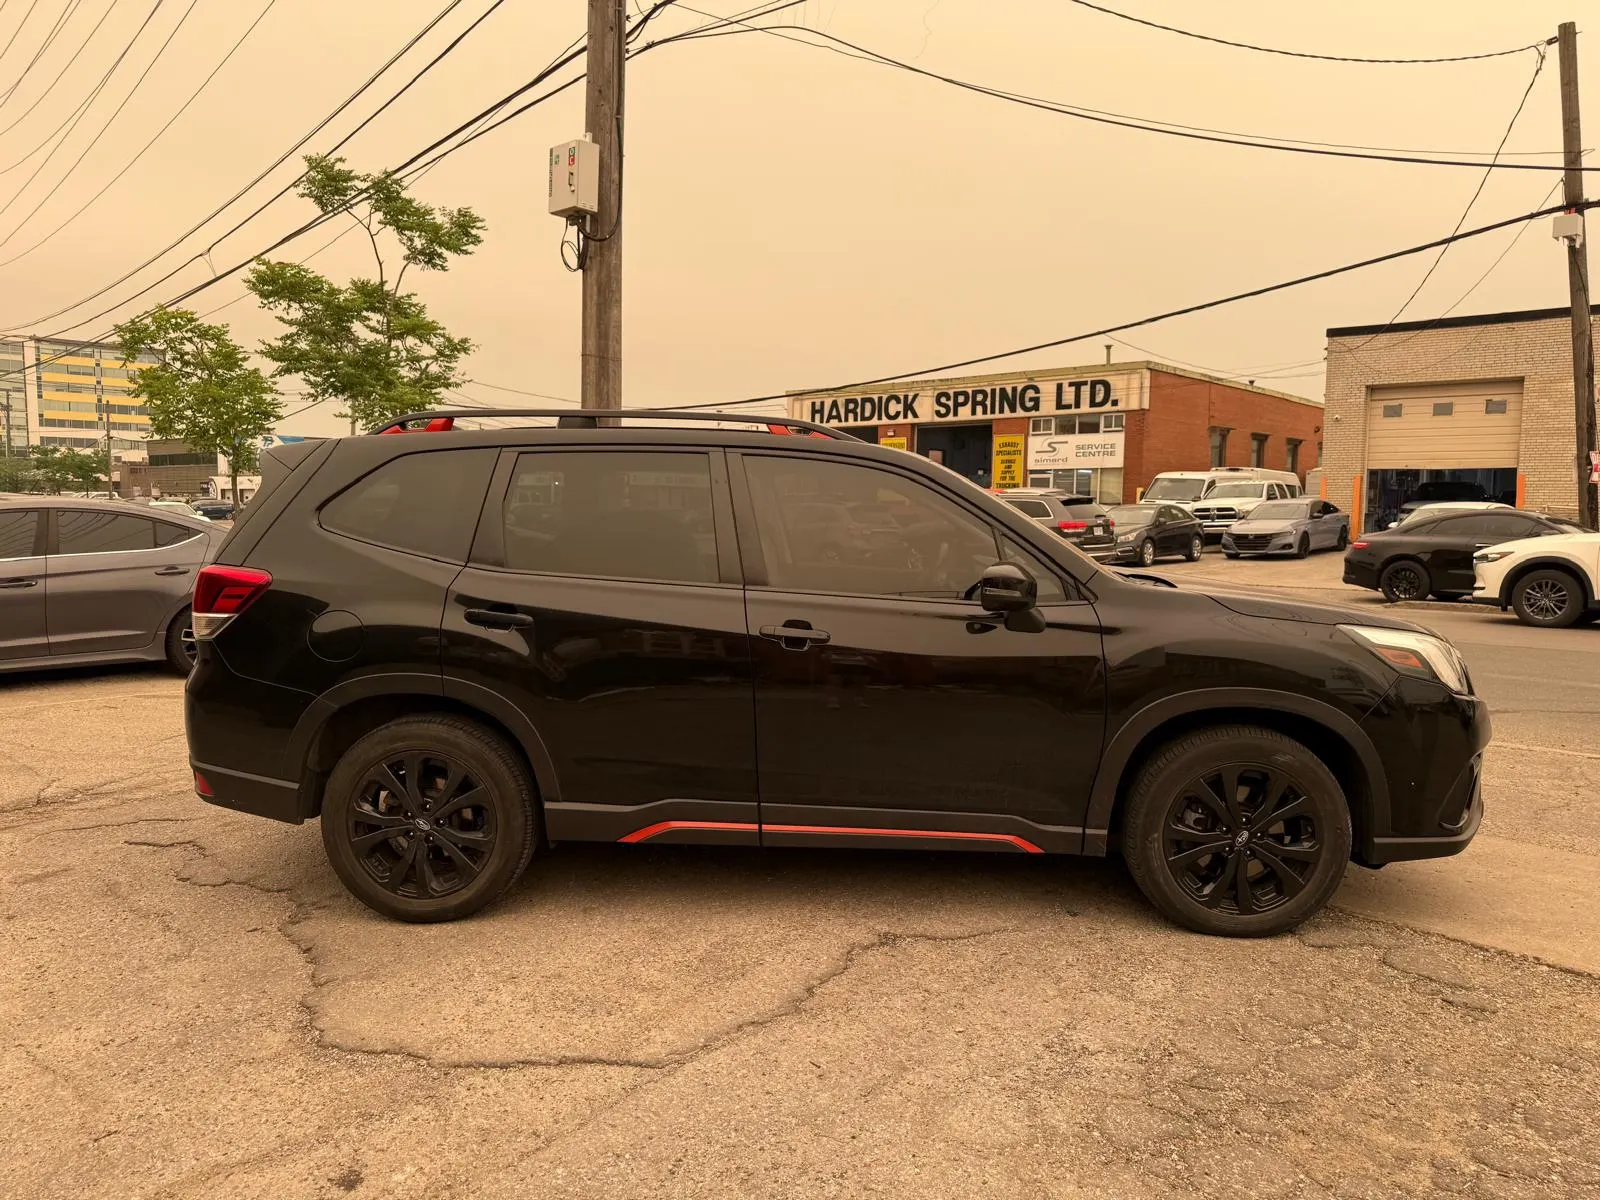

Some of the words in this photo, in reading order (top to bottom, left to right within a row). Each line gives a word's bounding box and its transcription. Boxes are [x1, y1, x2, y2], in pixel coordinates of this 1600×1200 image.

[810, 393, 920, 424] HARDICK
[934, 384, 1041, 419] SPRING
[1055, 379, 1119, 411] LTD.
